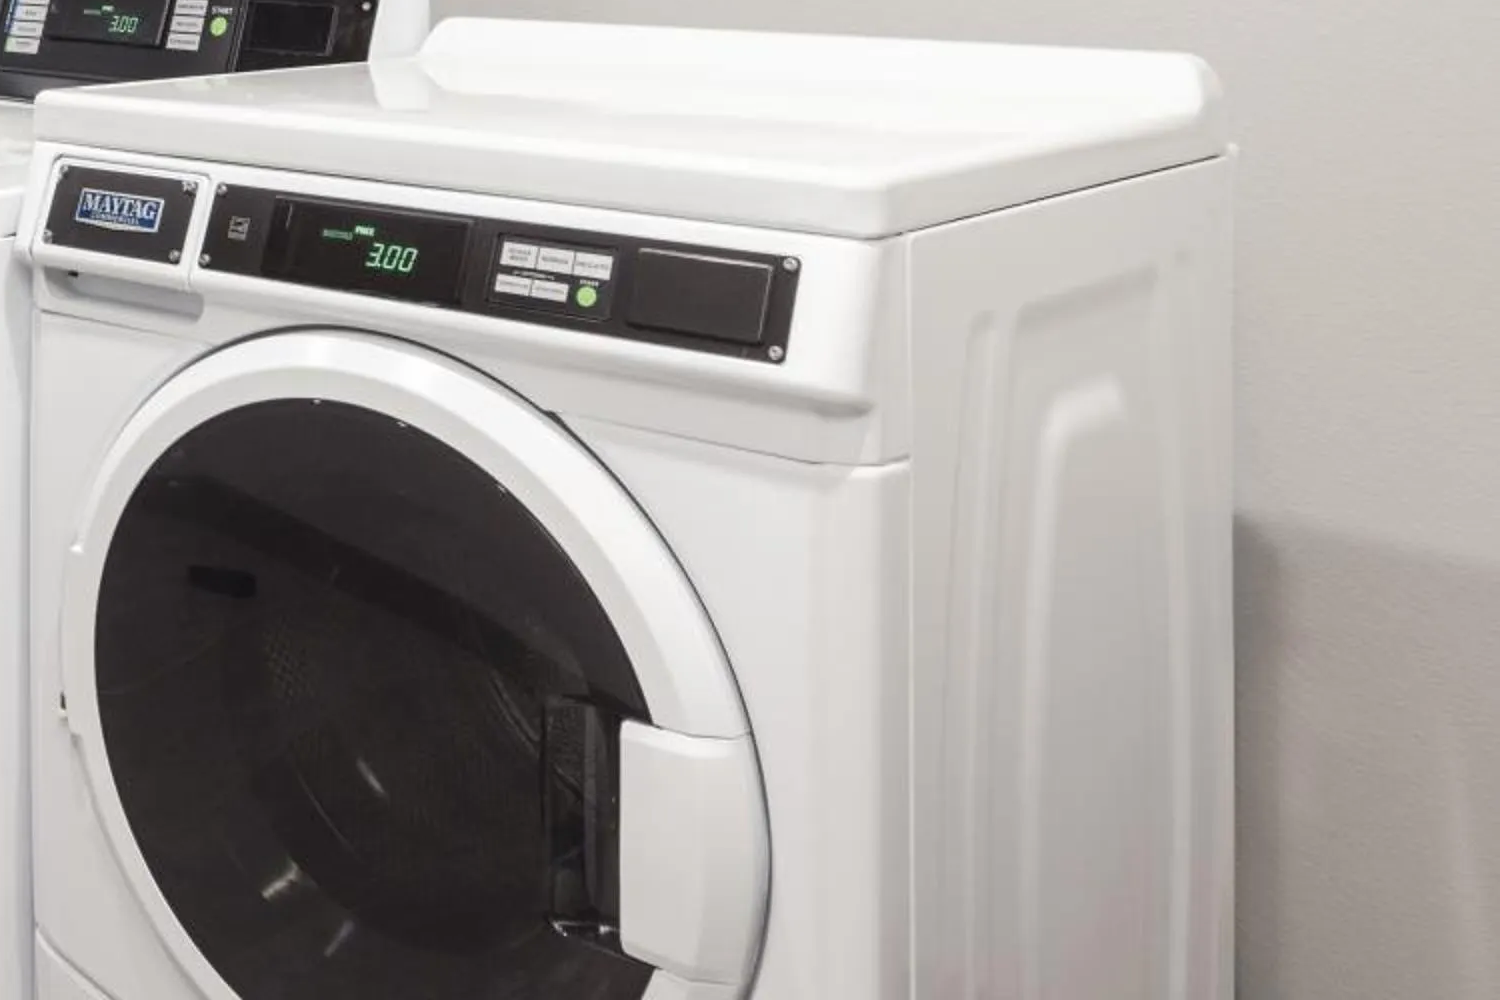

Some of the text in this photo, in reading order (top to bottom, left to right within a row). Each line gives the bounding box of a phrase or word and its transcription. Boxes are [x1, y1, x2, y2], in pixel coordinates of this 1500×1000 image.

[108, 15, 138, 33] 3.00
[83, 193, 156, 220] MAYTAG
[365, 242, 418, 272] 3.00
